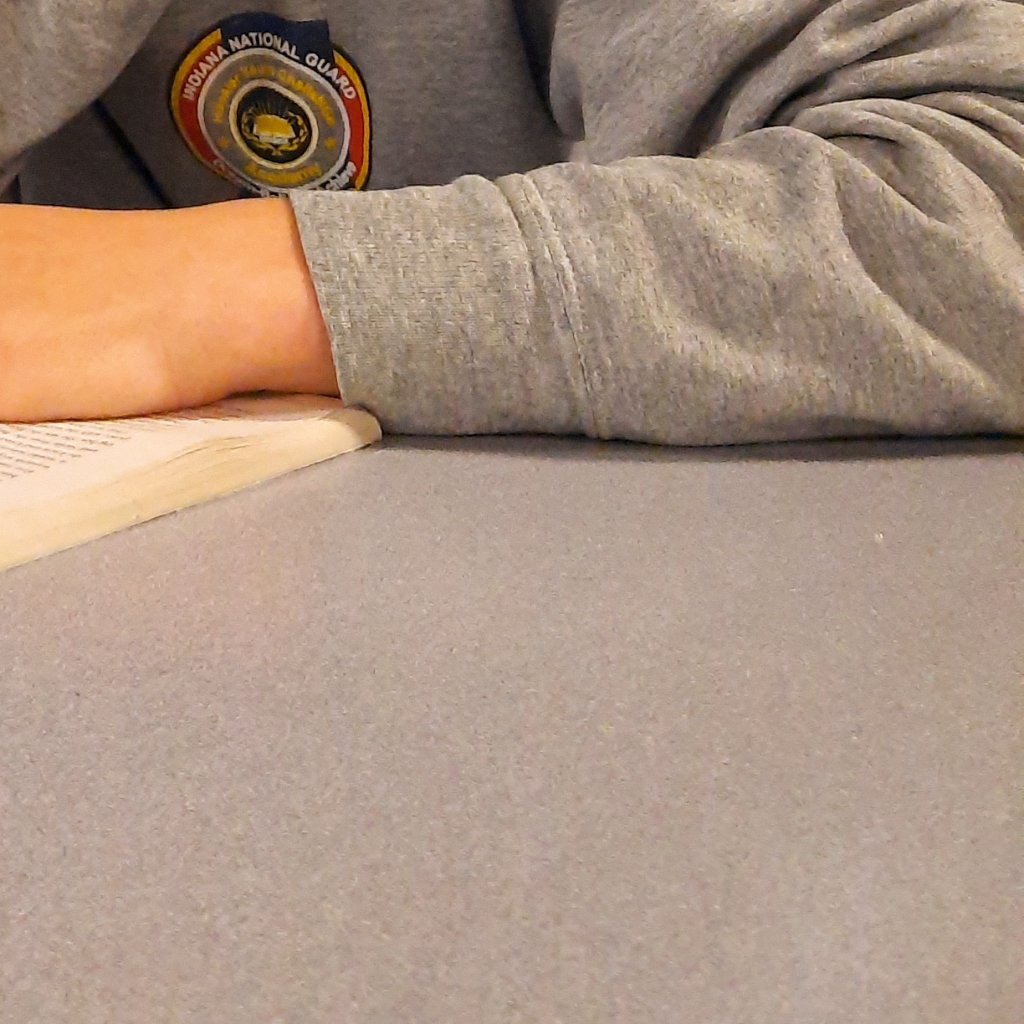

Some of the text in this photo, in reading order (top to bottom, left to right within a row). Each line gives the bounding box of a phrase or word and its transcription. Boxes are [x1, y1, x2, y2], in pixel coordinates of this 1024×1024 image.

[182, 45, 230, 101] INDIANA
[228, 31, 301, 61] NATIONAL
[304, 52, 358, 100] GUARD
